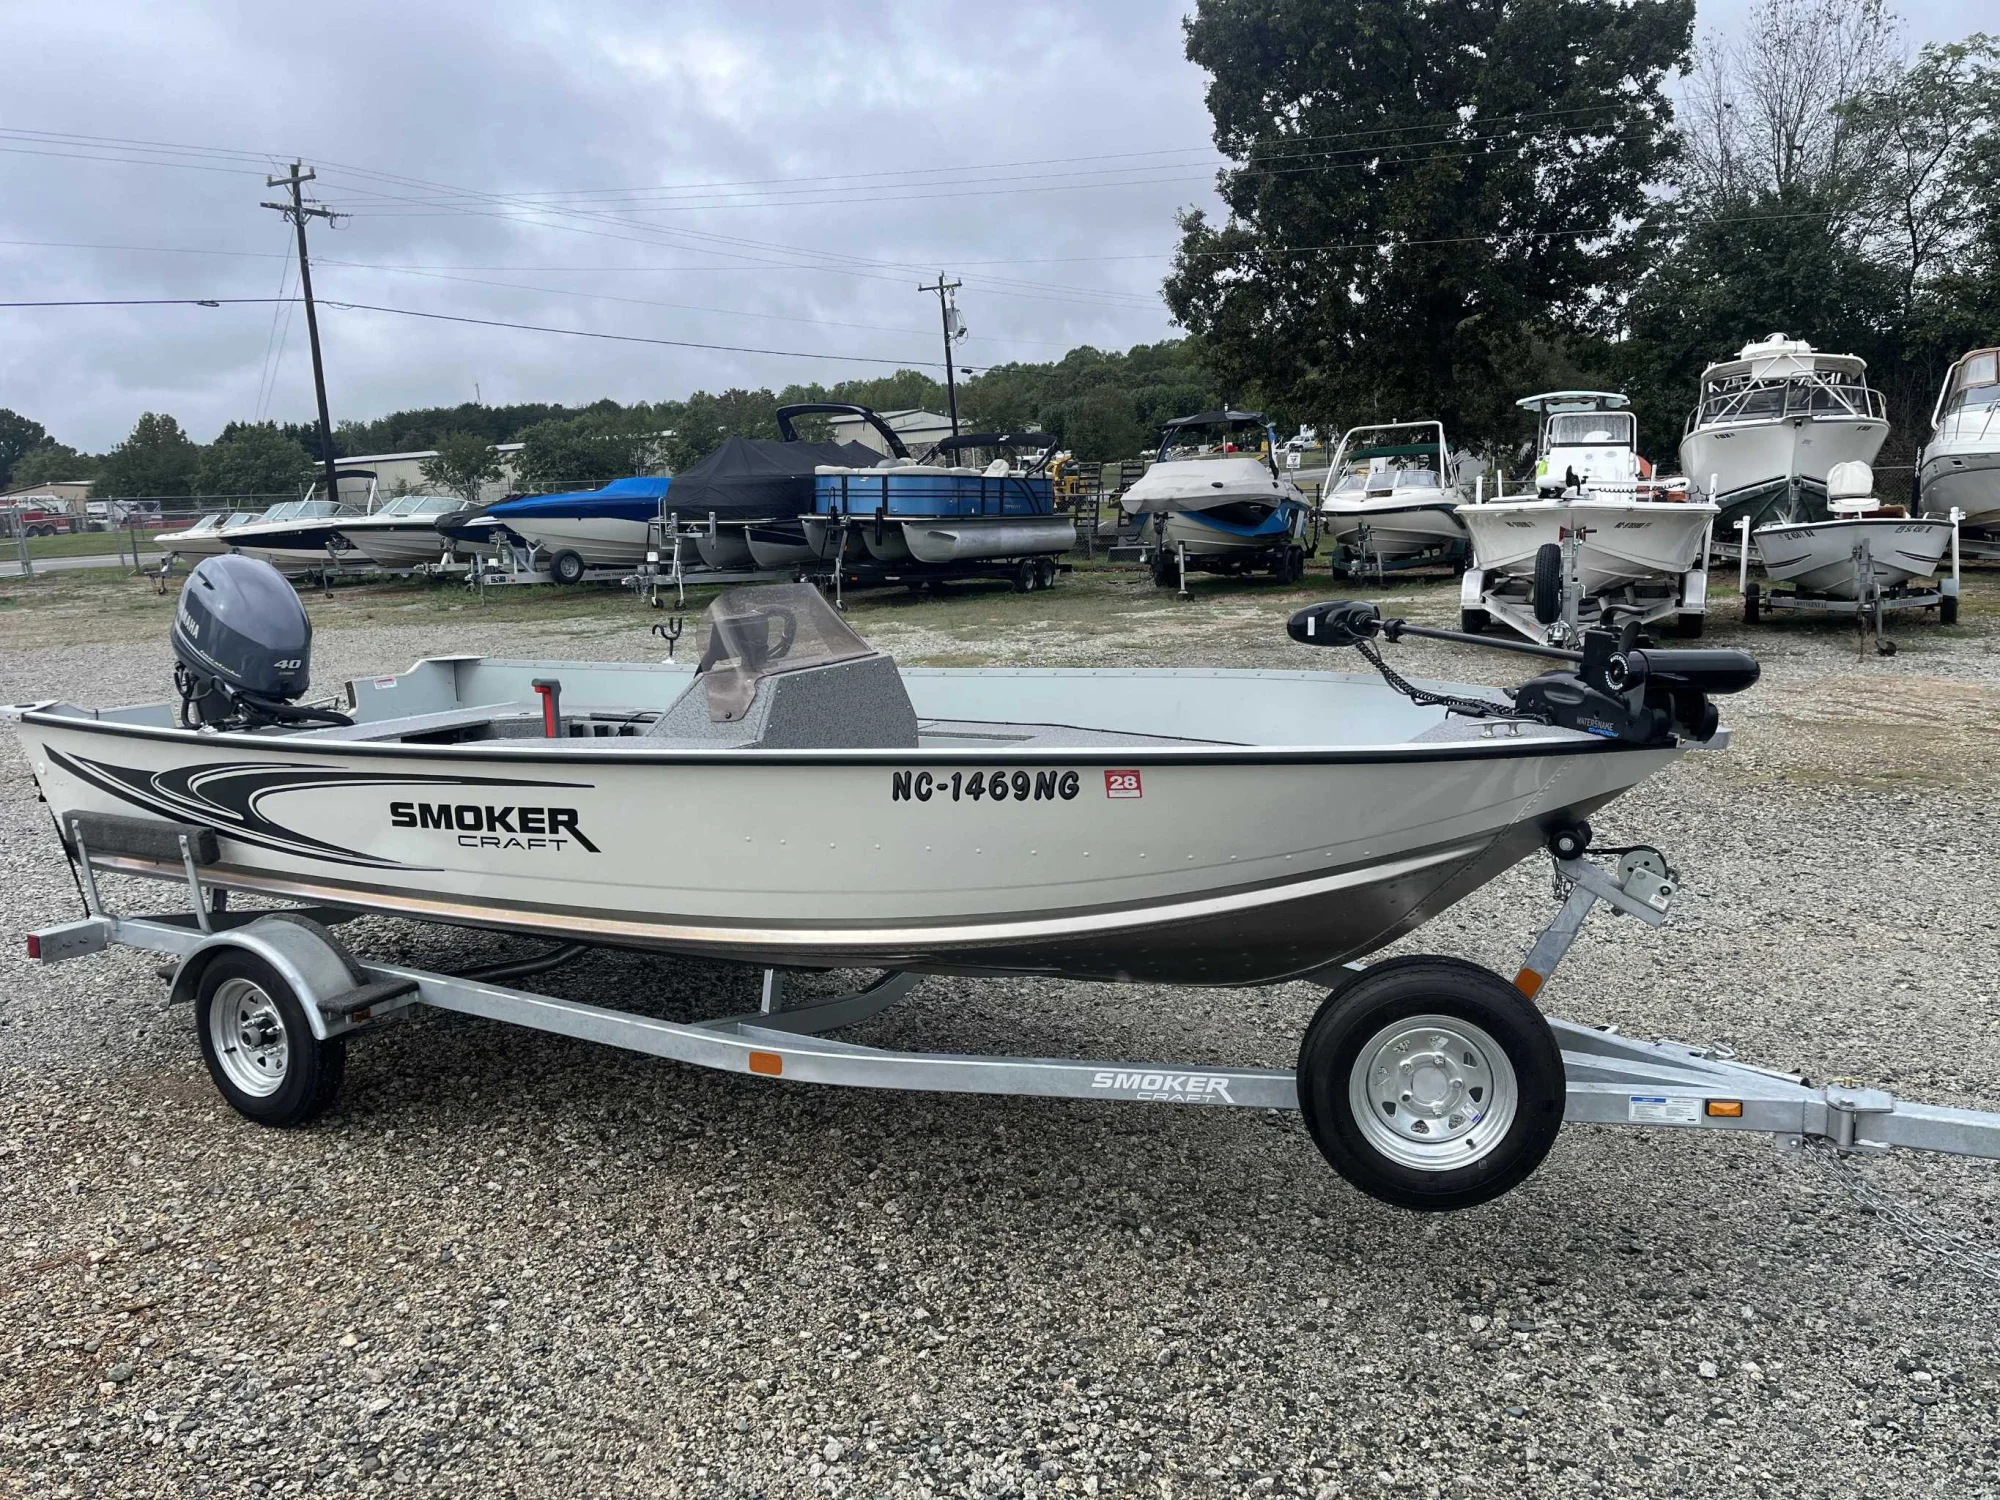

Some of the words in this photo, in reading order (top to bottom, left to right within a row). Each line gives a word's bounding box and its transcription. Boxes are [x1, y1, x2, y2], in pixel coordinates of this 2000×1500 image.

[273, 660, 302, 669] 40
[1576, 715, 1615, 732] WATERSNAKE
[892, 770, 1080, 801] NC-1469NG
[1110, 775, 1138, 790] 28
[390, 801, 602, 853] SMOKER
[458, 835, 568, 851] CRAFT
[1091, 1072, 1236, 1104] SMOKER
[1136, 1091, 1216, 1103] CRAFT
